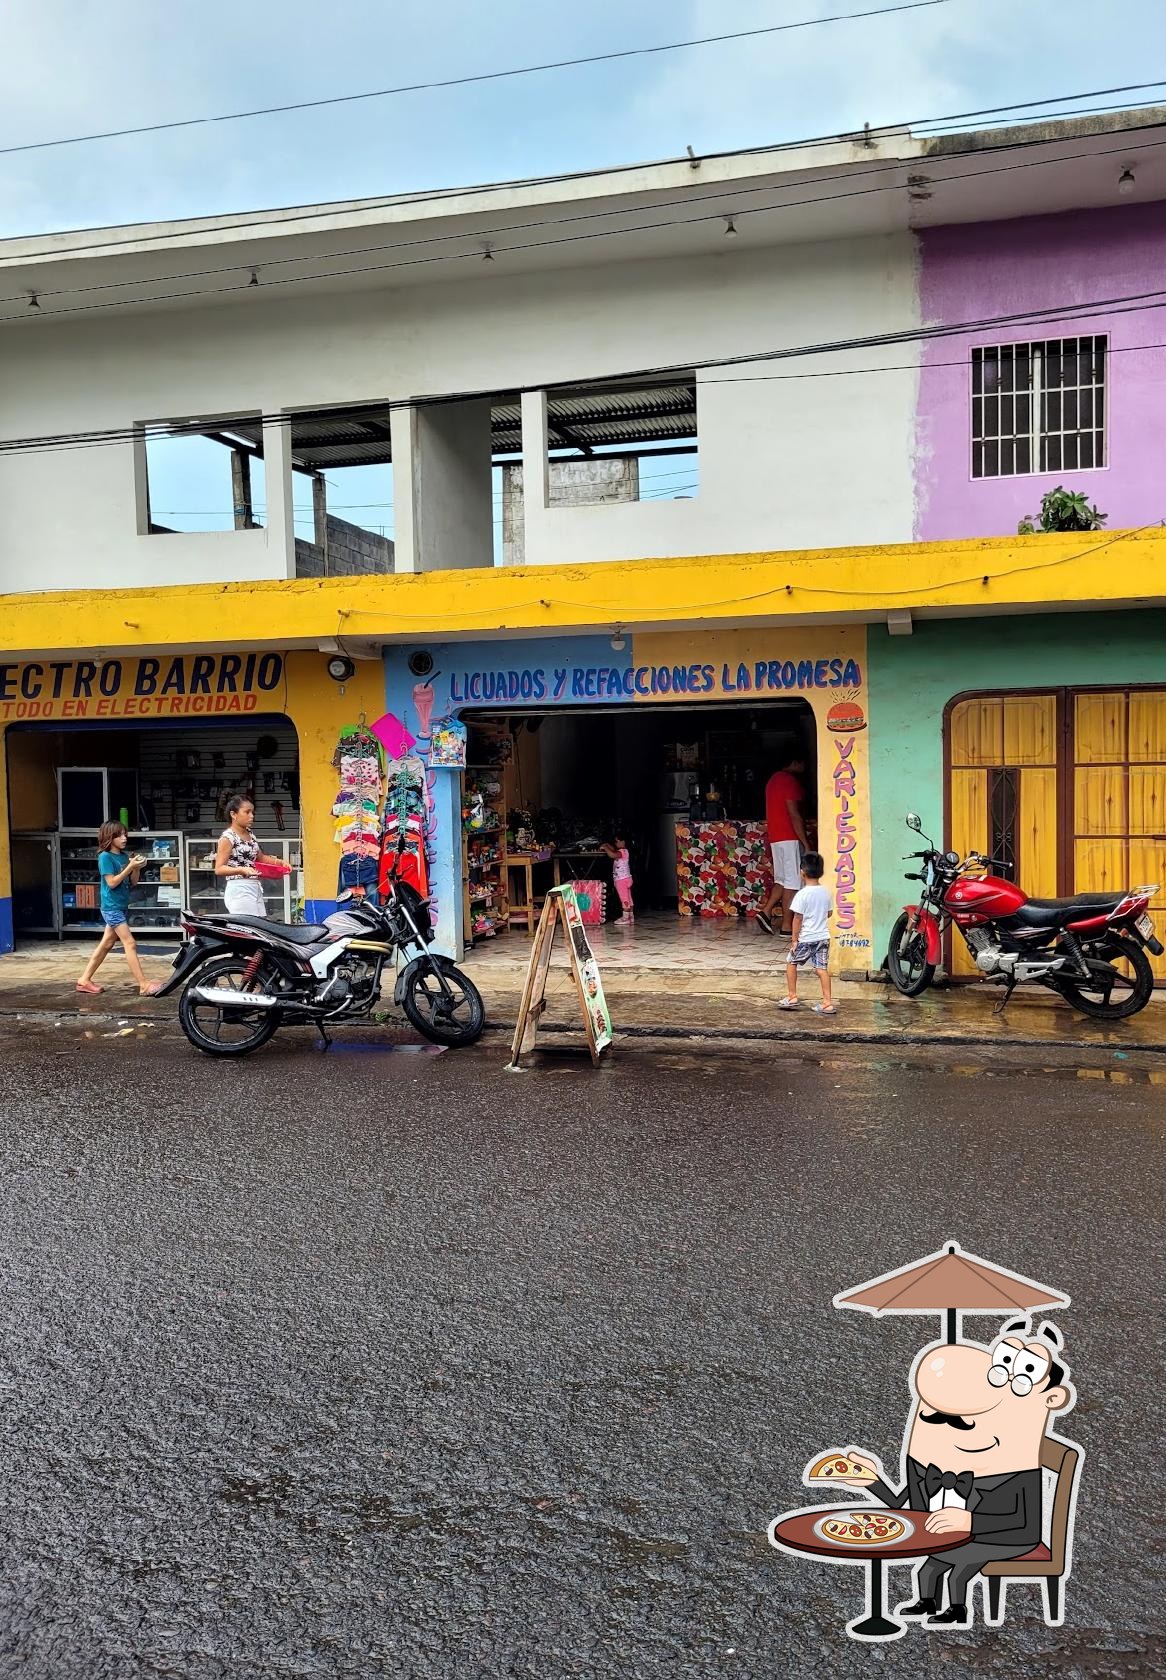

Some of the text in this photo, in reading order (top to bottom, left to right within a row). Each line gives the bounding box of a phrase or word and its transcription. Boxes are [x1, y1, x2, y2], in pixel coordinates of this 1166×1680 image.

[0, 653, 282, 699] ECTRO BARRIO
[450, 658, 862, 702] LICUADOS Y REFACCIONES LA PROMESA
[3, 693, 257, 718] TODO EN ELECTRICIDAD
[833, 736, 857, 929] VARIEDADES
